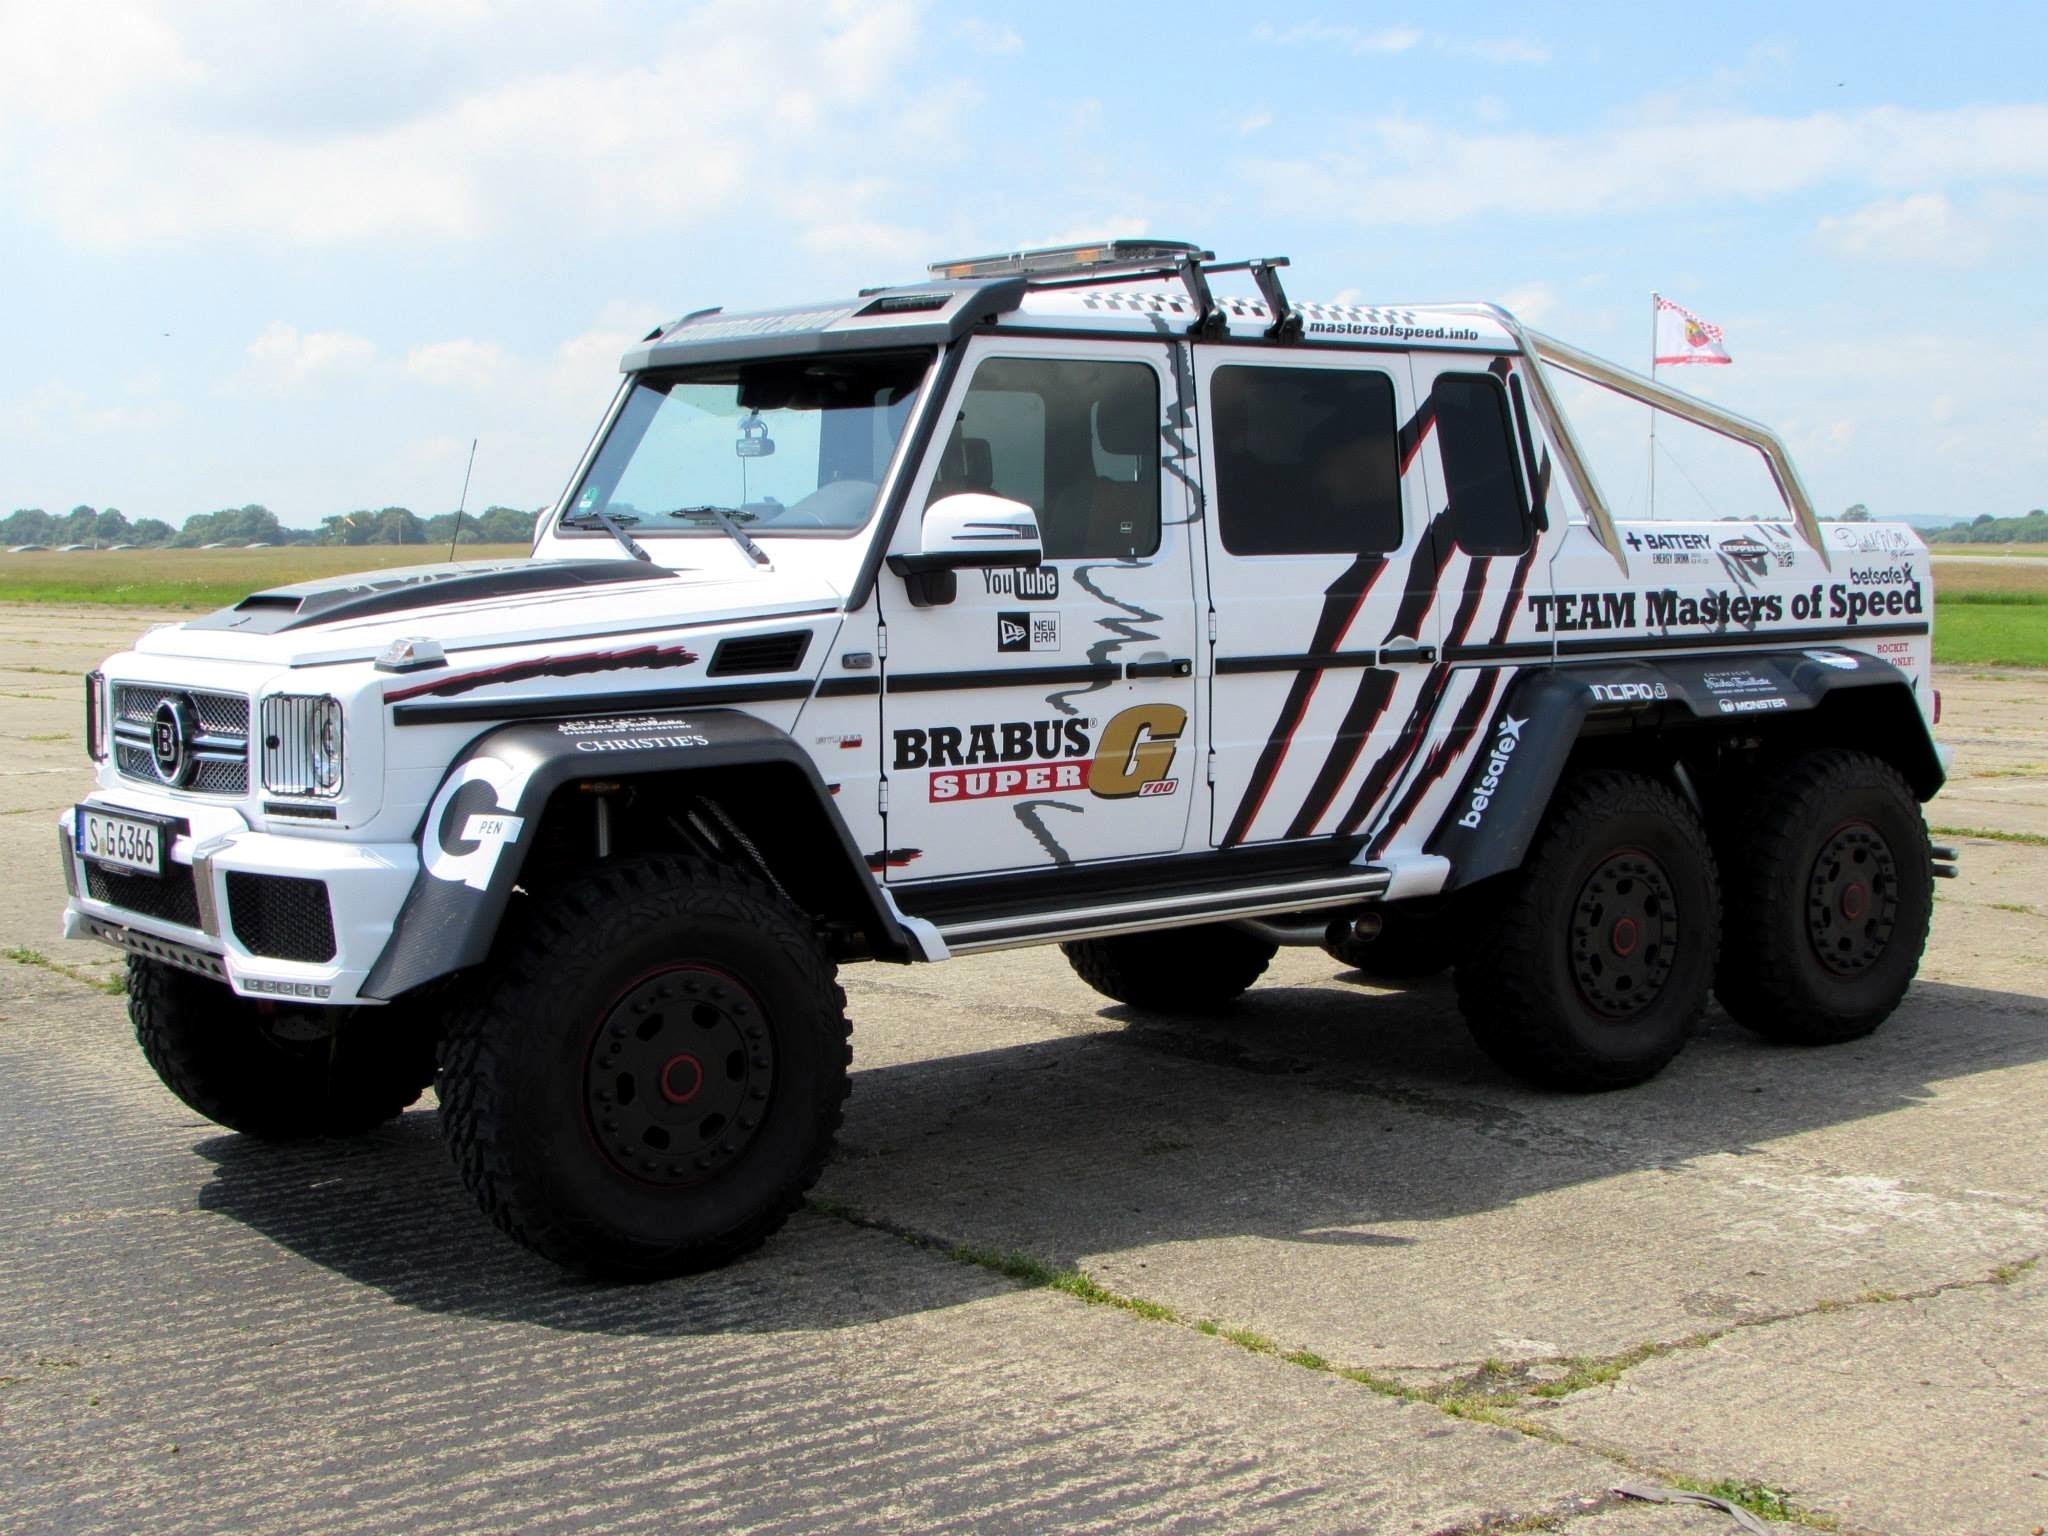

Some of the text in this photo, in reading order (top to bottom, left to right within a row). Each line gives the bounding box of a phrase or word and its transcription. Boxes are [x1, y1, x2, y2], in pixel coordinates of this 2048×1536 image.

[1644, 534, 1712, 550] BATTERY
[1850, 566, 1902, 585] betsafe
[1528, 581, 1923, 633] TEAM Masters of Speed
[1033, 620, 1056, 632] NEW
[1033, 631, 1056, 643] ERA
[1877, 642, 1909, 653] ROCKET
[1589, 684, 1651, 701] INCIPIO
[1735, 698, 1788, 711] MONSTER
[576, 734, 709, 752] CHRISTIE'S
[1088, 703, 1188, 799] G
[933, 764, 1081, 798] SUPER
[1142, 780, 1176, 795] 700
[1458, 737, 1516, 829] betsafe
[479, 820, 503, 836] PEN
